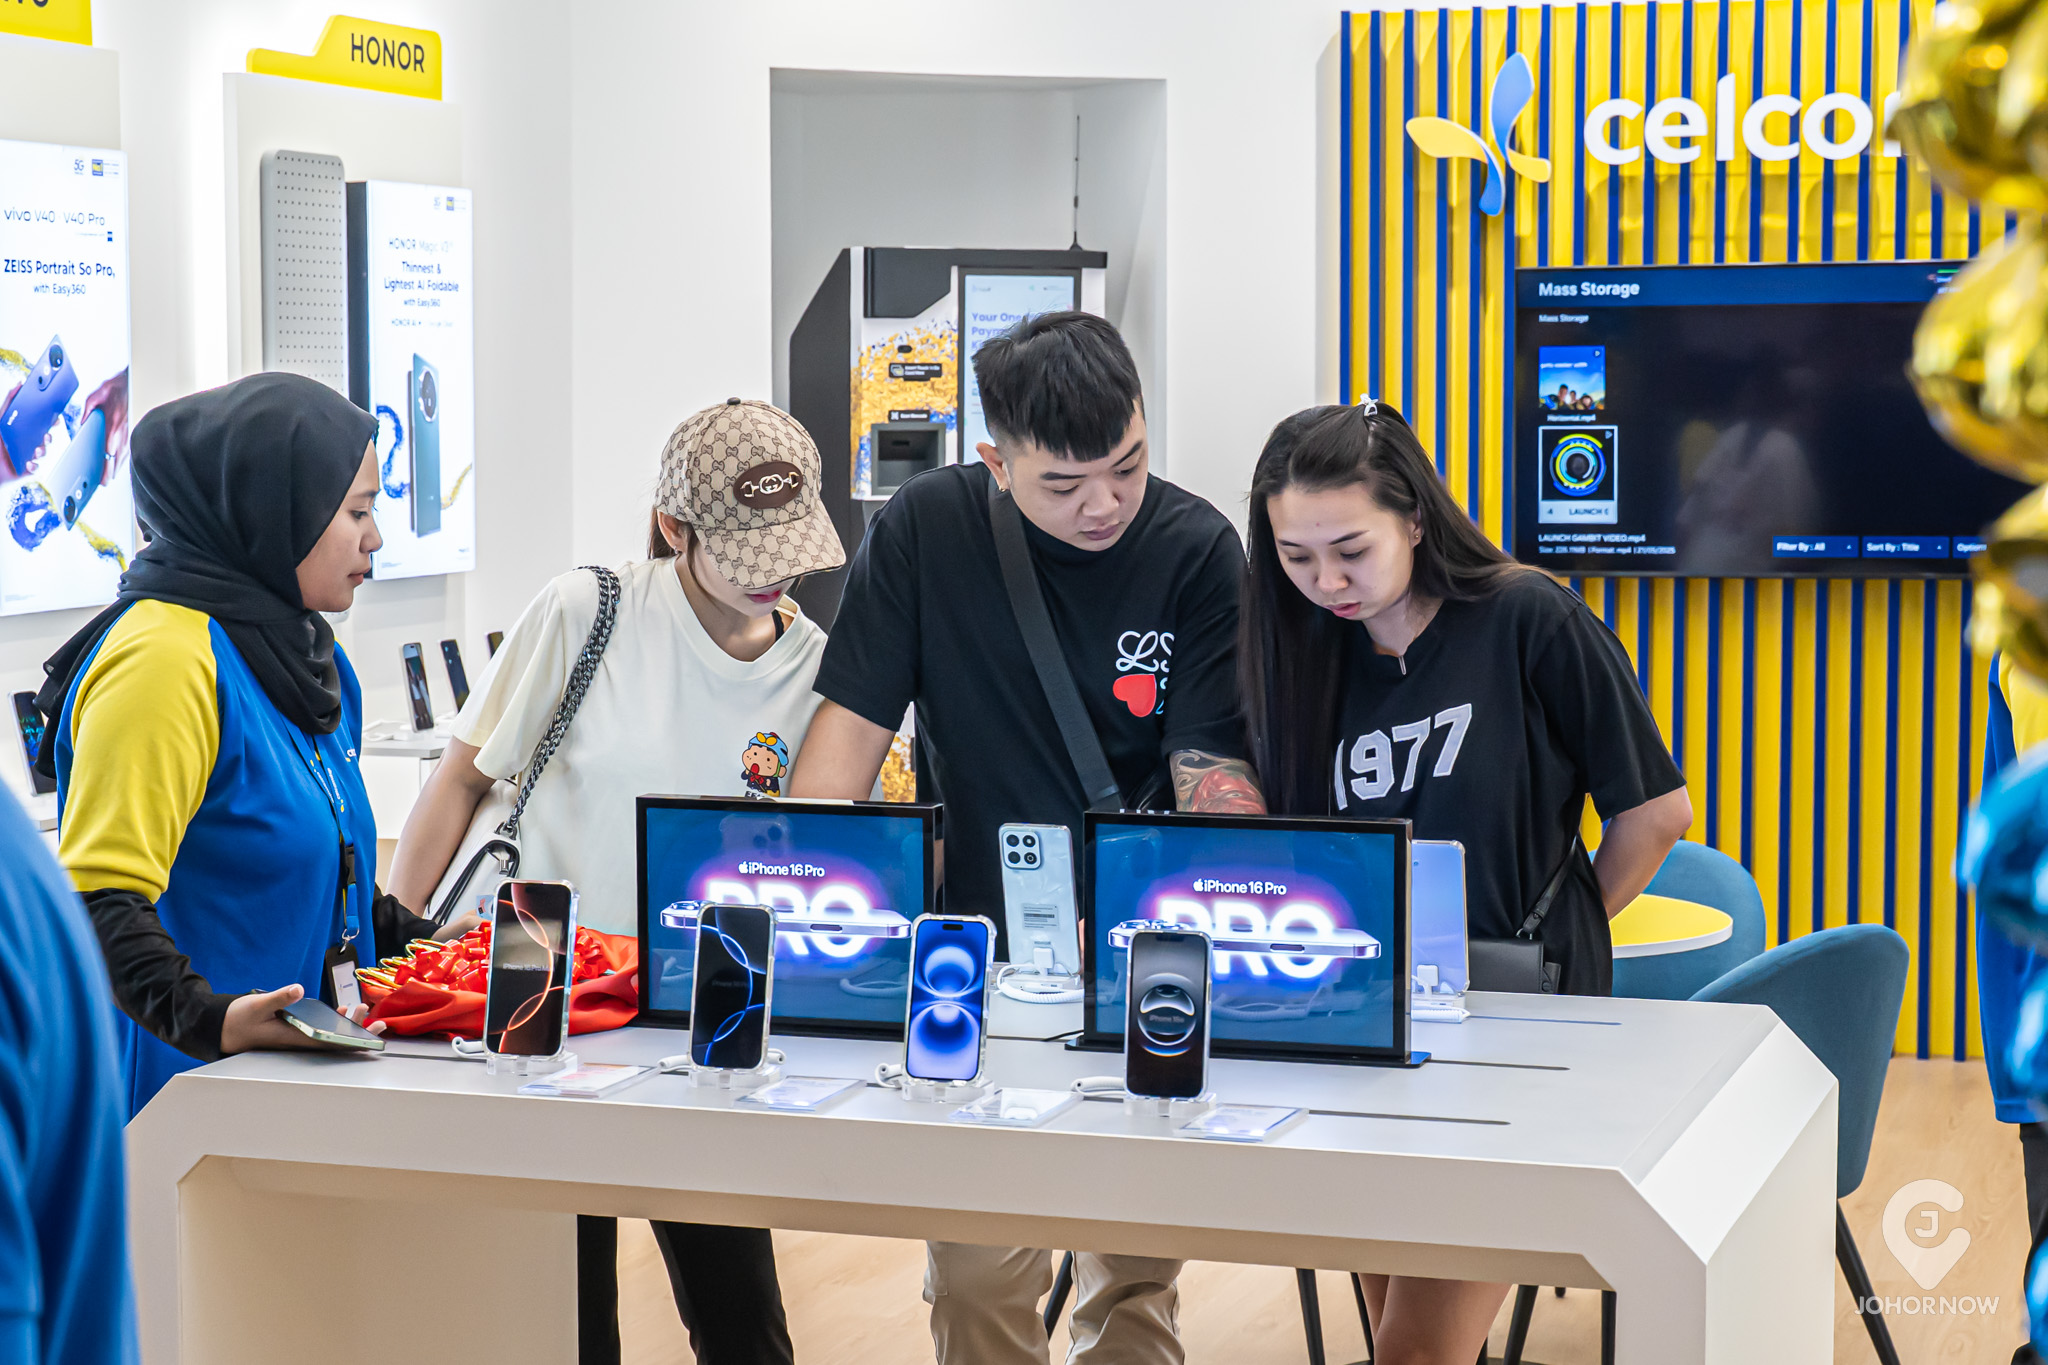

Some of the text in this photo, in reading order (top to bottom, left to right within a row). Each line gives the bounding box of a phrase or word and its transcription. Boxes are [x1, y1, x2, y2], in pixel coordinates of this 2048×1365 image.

[351, 33, 425, 73] HONOR
[1584, 72, 1902, 165] celco
[4, 207, 105, 225] vivo V40 V40 Pro
[389, 238, 416, 250] HONOR
[4, 259, 115, 278] ZEISS Portrait So Pro,
[402, 261, 434, 274] Thinnest
[34, 284, 86, 297] with Easy360
[384, 276, 414, 292] Lightest
[428, 280, 459, 292] Foldable
[1539, 281, 1640, 298] Mass Storage
[972, 313, 997, 322] Your
[1867, 542, 1884, 551] Sort
[1334, 703, 1472, 811] 1977
[748, 862, 825, 877] iPhone 16 Pro
[1204, 879, 1287, 896] iPhone 16 Pro
